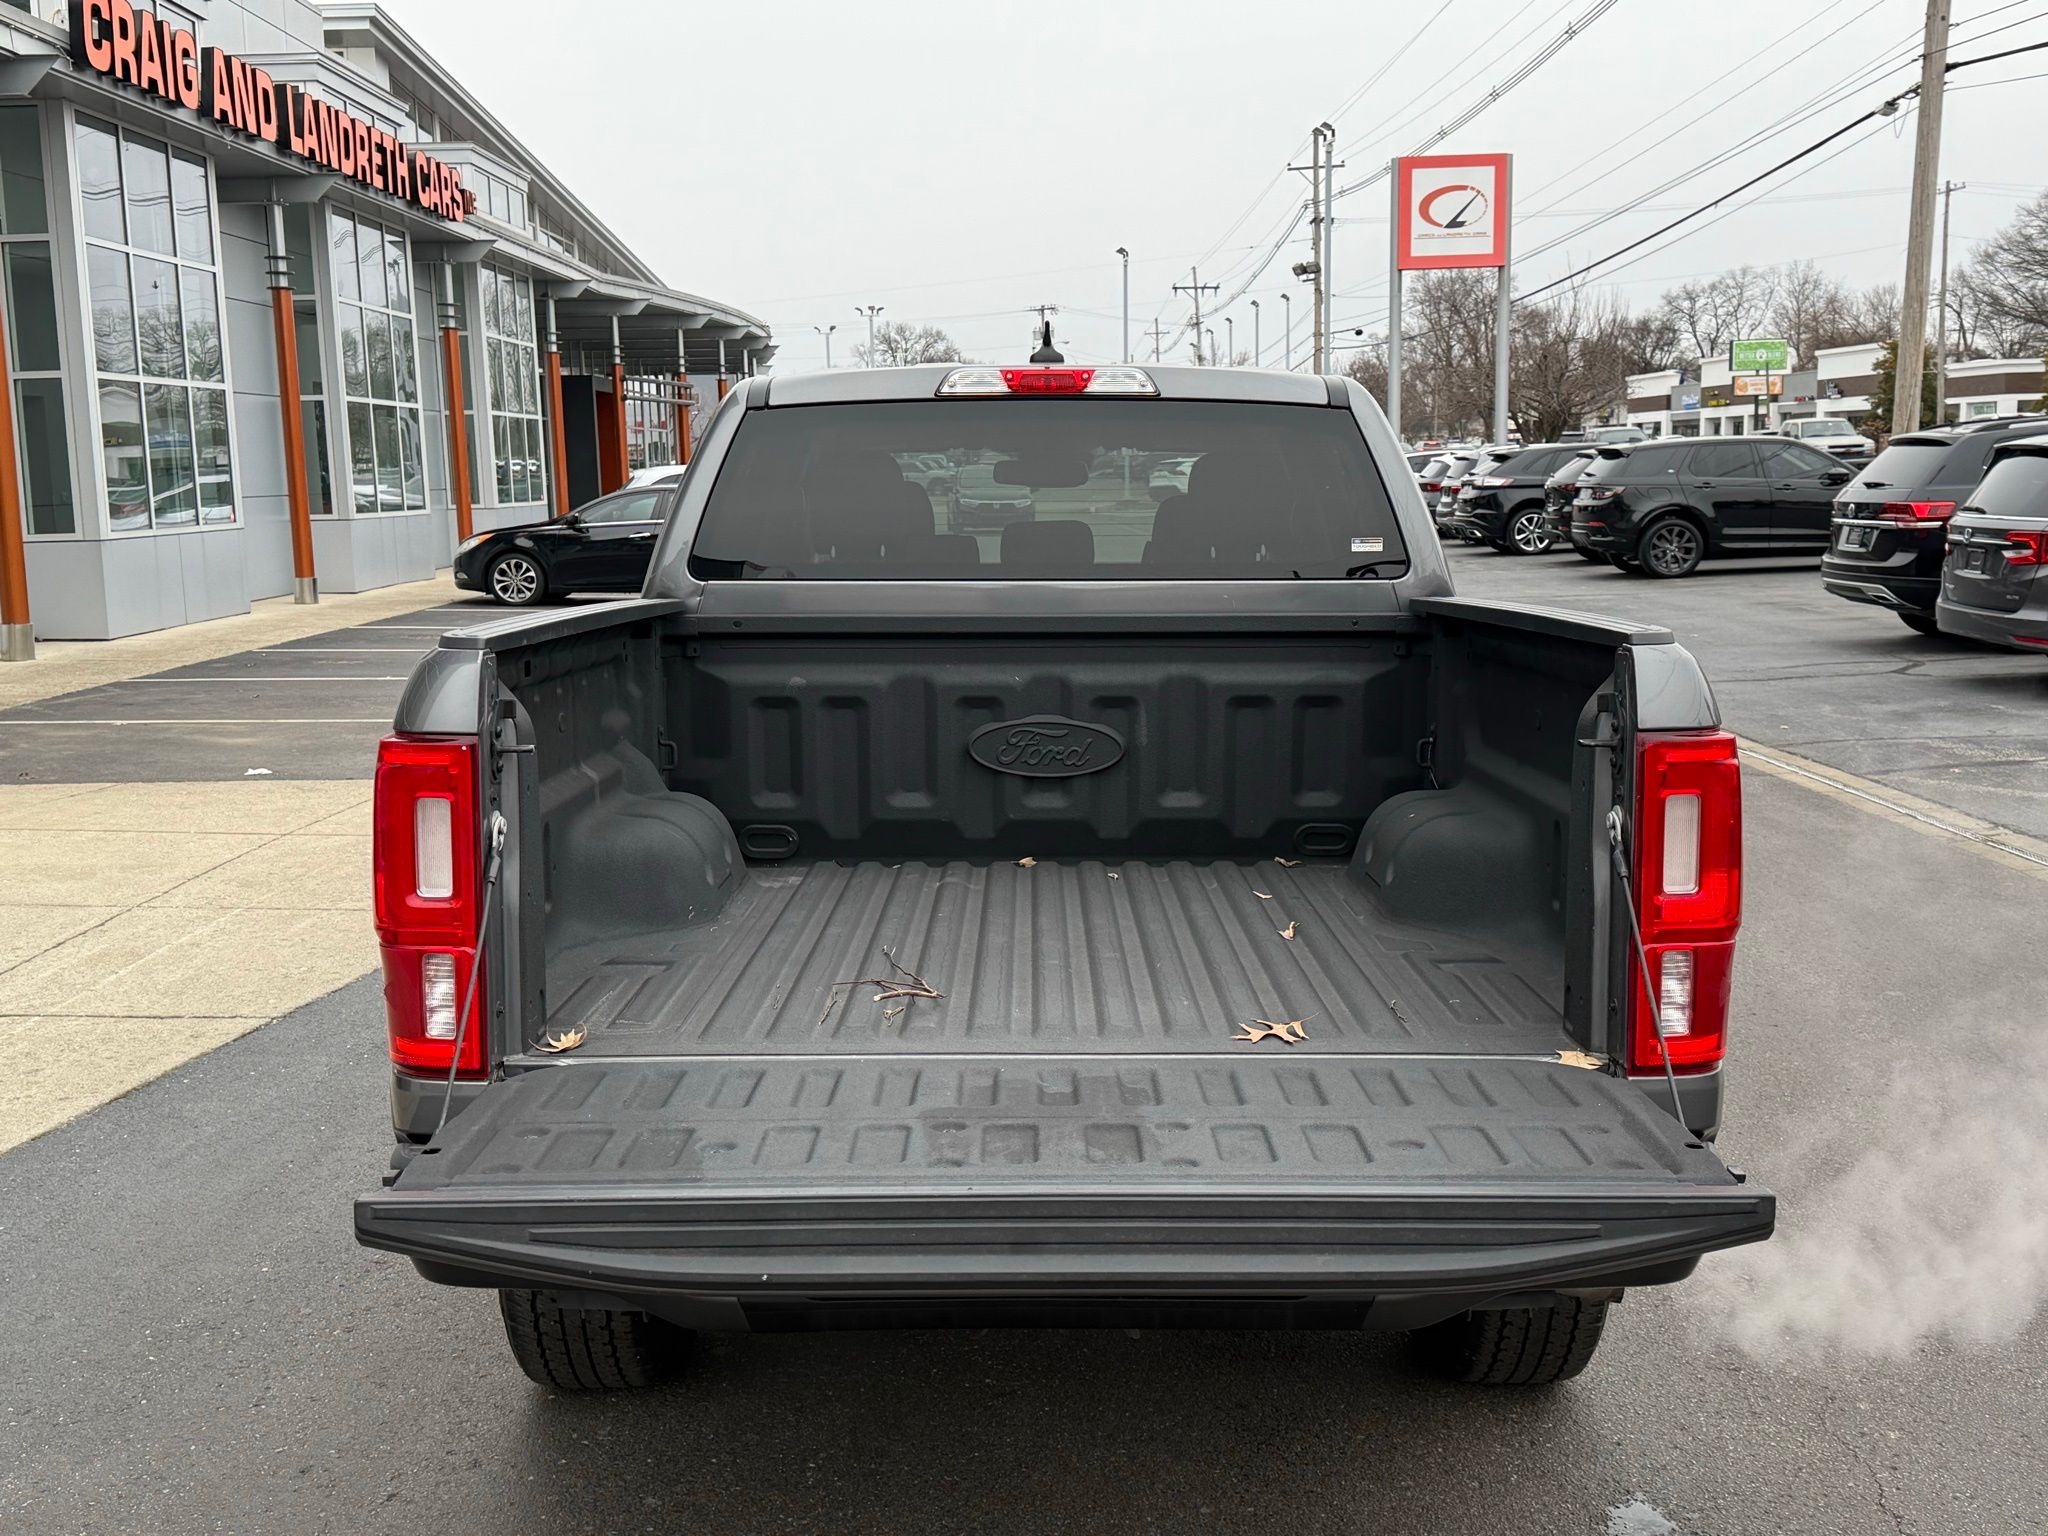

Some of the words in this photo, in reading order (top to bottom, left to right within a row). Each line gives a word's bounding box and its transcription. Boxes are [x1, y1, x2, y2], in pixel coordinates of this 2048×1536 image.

[82, 0, 199, 110] CRAIG
[213, 47, 277, 142] AND
[286, 84, 410, 200] LANDRETH
[416, 150, 464, 223] CARS
[996, 726, 1093, 767] Ford
